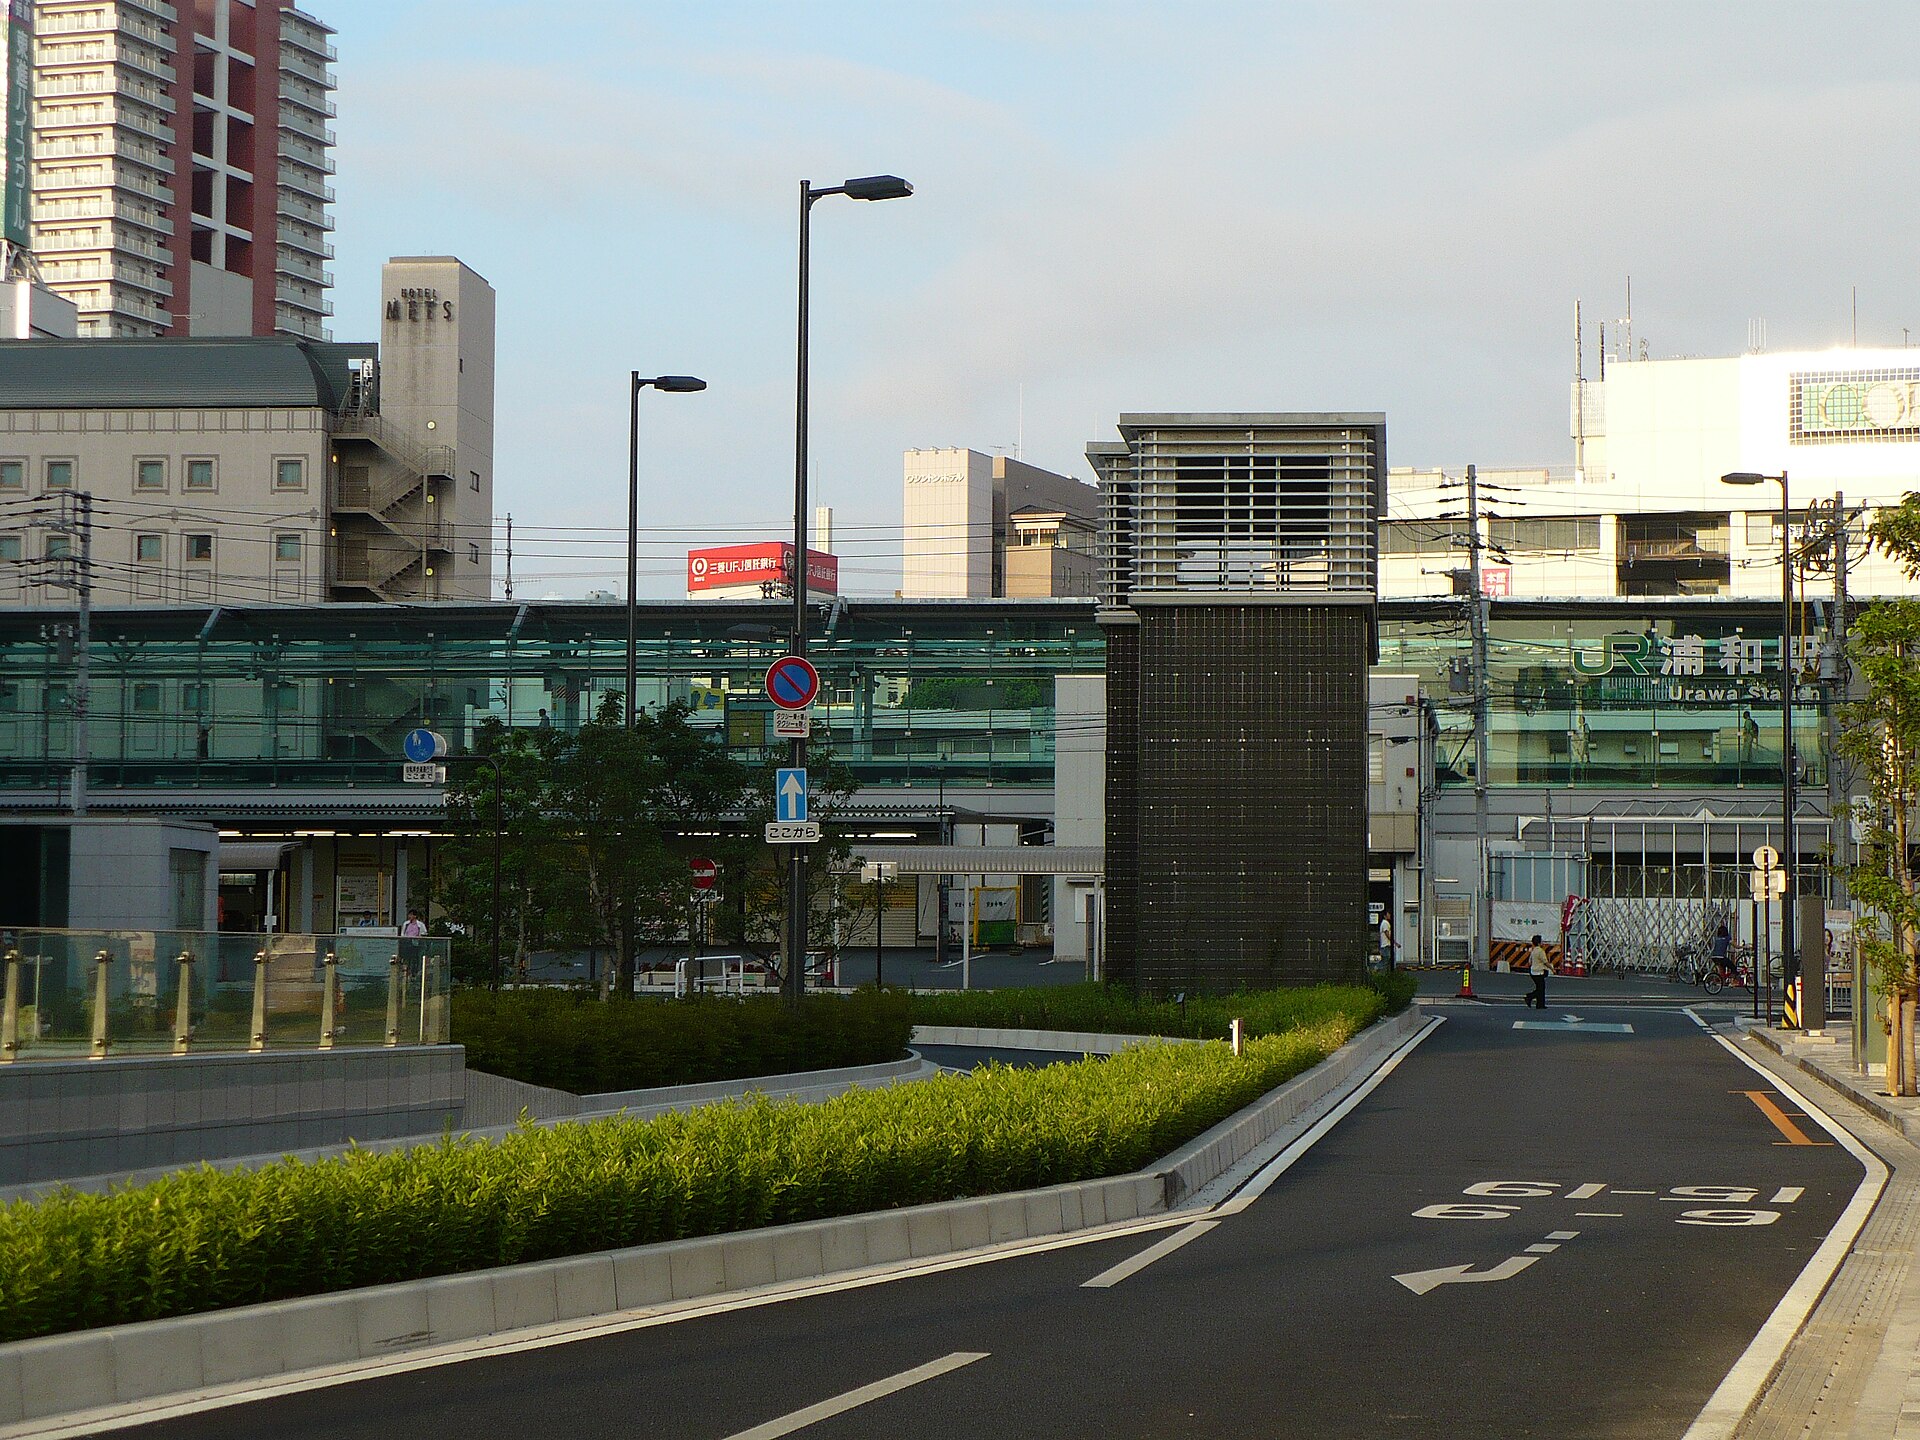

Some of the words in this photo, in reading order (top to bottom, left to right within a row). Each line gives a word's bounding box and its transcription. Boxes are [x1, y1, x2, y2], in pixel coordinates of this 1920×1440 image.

[401, 288, 438, 299] HOTEL
[386, 299, 454, 322] METS
[709, 556, 777, 576] 三菱UFJ信託銀行
[1573, 634, 1650, 676] JR
[1669, 685, 1738, 701] Urawa
[769, 826, 816, 838] ここから
